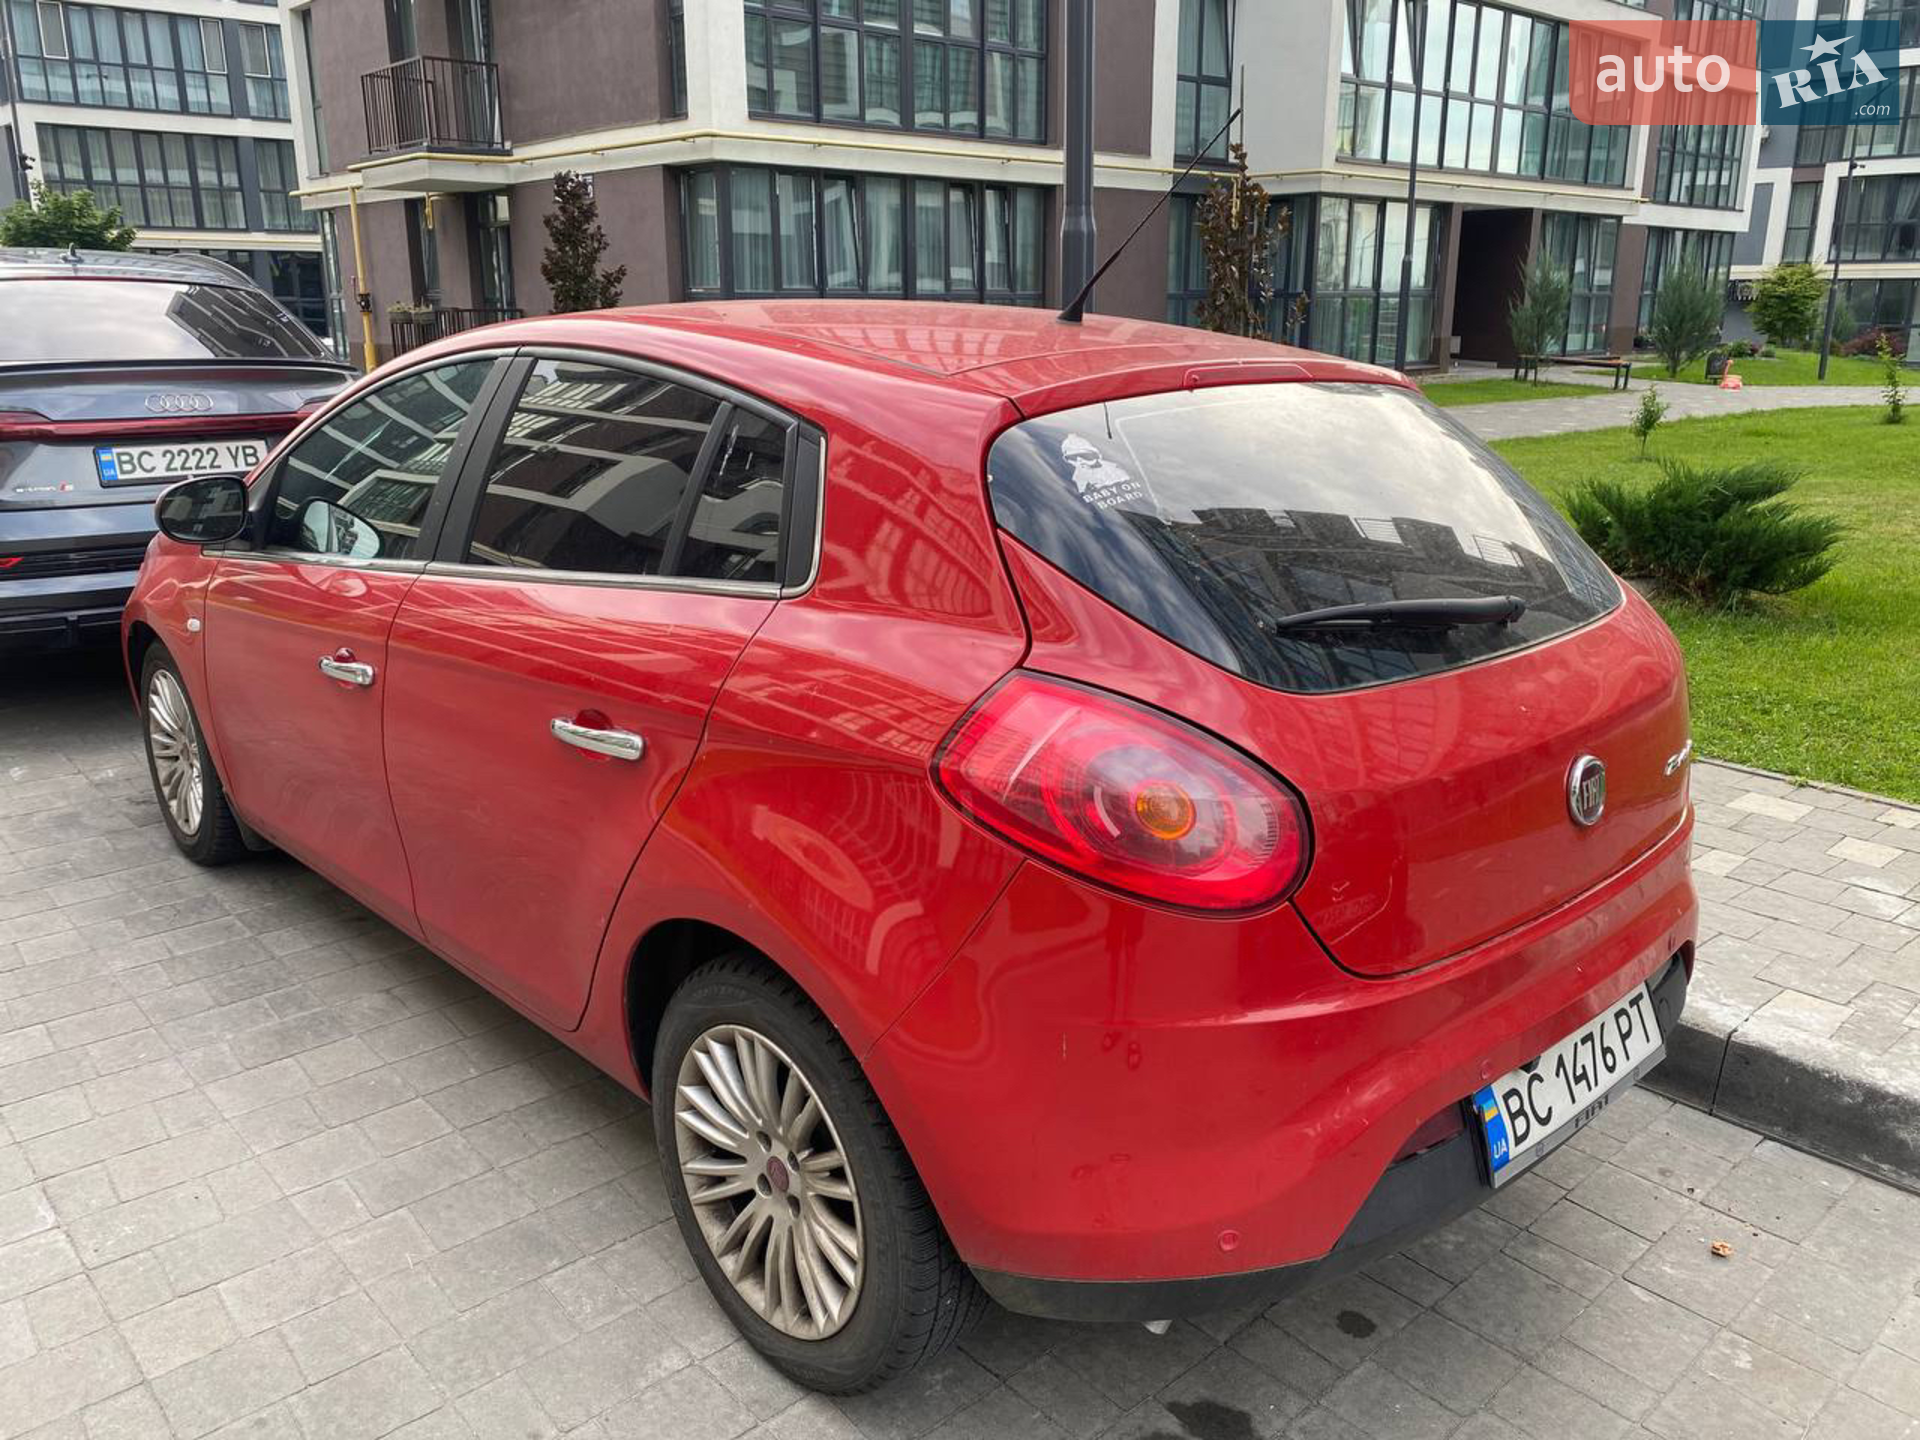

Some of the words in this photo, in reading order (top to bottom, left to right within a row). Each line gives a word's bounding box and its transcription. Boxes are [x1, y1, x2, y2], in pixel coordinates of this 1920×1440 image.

[118, 451, 156, 475] BC
[162, 447, 221, 472] 2222
[226, 445, 260, 468] YB
[1082, 486, 1118, 503] BABY
[1121, 482, 1141, 492] ON
[1097, 491, 1143, 509] BOARD
[1502, 1073, 1552, 1147] BC
[1555, 1022, 1617, 1105] 1476
[1613, 992, 1651, 1062] PT
[1493, 1139, 1508, 1159] UA
